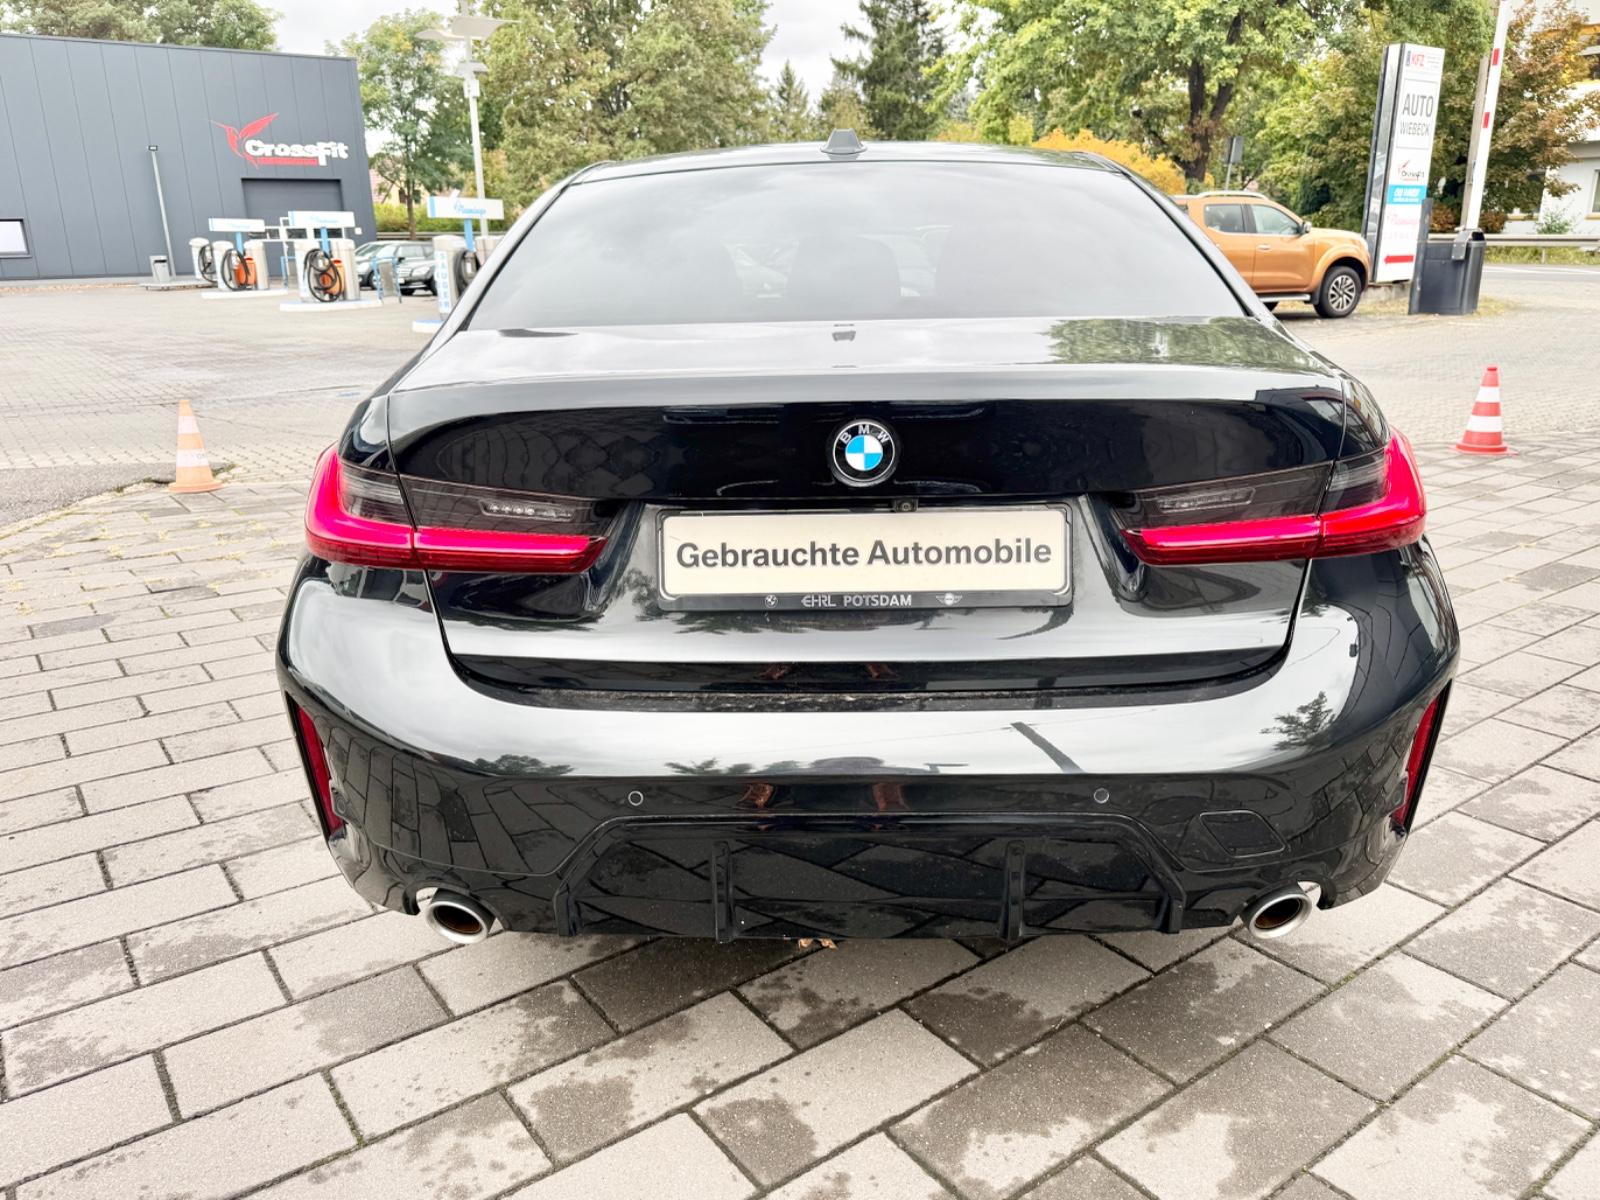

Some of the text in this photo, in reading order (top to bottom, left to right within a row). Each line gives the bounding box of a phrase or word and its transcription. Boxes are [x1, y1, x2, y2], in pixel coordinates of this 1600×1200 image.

[1402, 93, 1434, 118] AUTO
[244, 139, 349, 166] CrossFit
[839, 424, 890, 445] BMW
[676, 537, 1052, 568] Gebrauchte Automobile
[843, 594, 912, 607] POTSDAM
